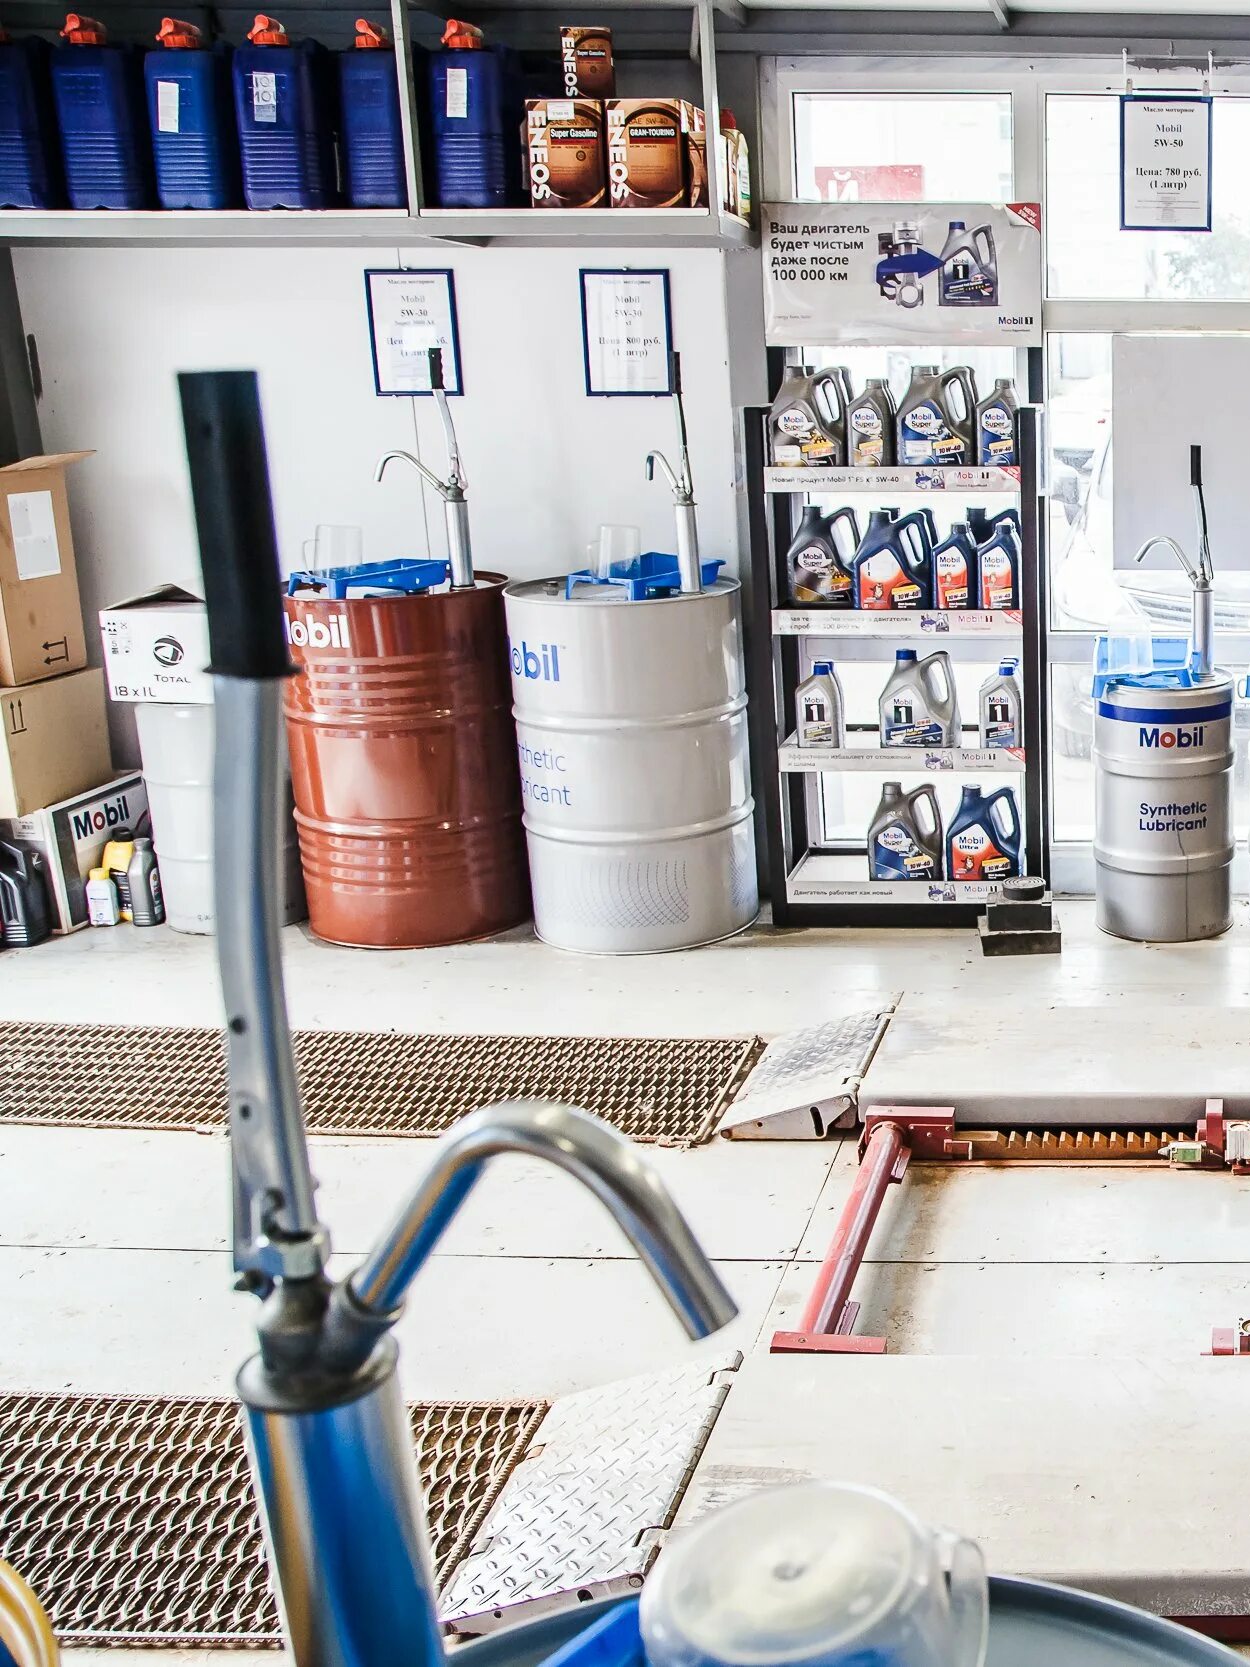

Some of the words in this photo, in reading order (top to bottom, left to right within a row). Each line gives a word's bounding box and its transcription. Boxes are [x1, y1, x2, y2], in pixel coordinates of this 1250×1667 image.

[562, 37, 578, 97] ENEOS
[550, 129, 569, 139] Super
[570, 128, 598, 138] Gasoline
[629, 128, 675, 137] GRAN-TOURING
[1156, 124, 1182, 133] Mobil
[1154, 139, 1184, 148] 5W-50
[527, 110, 550, 200] ENEOS
[607, 109, 630, 200] ENEOS
[1135, 168, 1163, 178] Цена:
[1165, 168, 1181, 177] 780
[1183, 167, 1202, 178] руб.
[1160, 180, 1188, 190] литр)
[770, 222, 799, 235] Ваш
[801, 224, 870, 237] двигатель
[770, 237, 810, 251] будет
[813, 240, 864, 250] чистым
[771, 255, 807, 267] даже
[810, 256, 849, 265] после
[772, 270, 798, 282] 100
[800, 270, 826, 282] 000
[829, 271, 848, 282] км
[401, 295, 425, 303] Mobil
[616, 296, 640, 304] Mobil
[400, 309, 428, 317] 5W-30
[998, 316, 1023, 325] Mobil
[643, 337, 661, 347] руб.
[784, 423, 804, 431] Super
[509, 636, 560, 682] obil
[154, 674, 192, 684] TOTAL
[114, 685, 129, 697] 18
[1139, 727, 1205, 748] Mobil
[518, 741, 566, 772] thetic
[1139, 800, 1208, 819] Synthetic
[73, 795, 130, 841] Mobil
[1139, 816, 1208, 832] Lubricant
[959, 836, 984, 845] Mobil
[964, 885, 988, 893] Mobil
